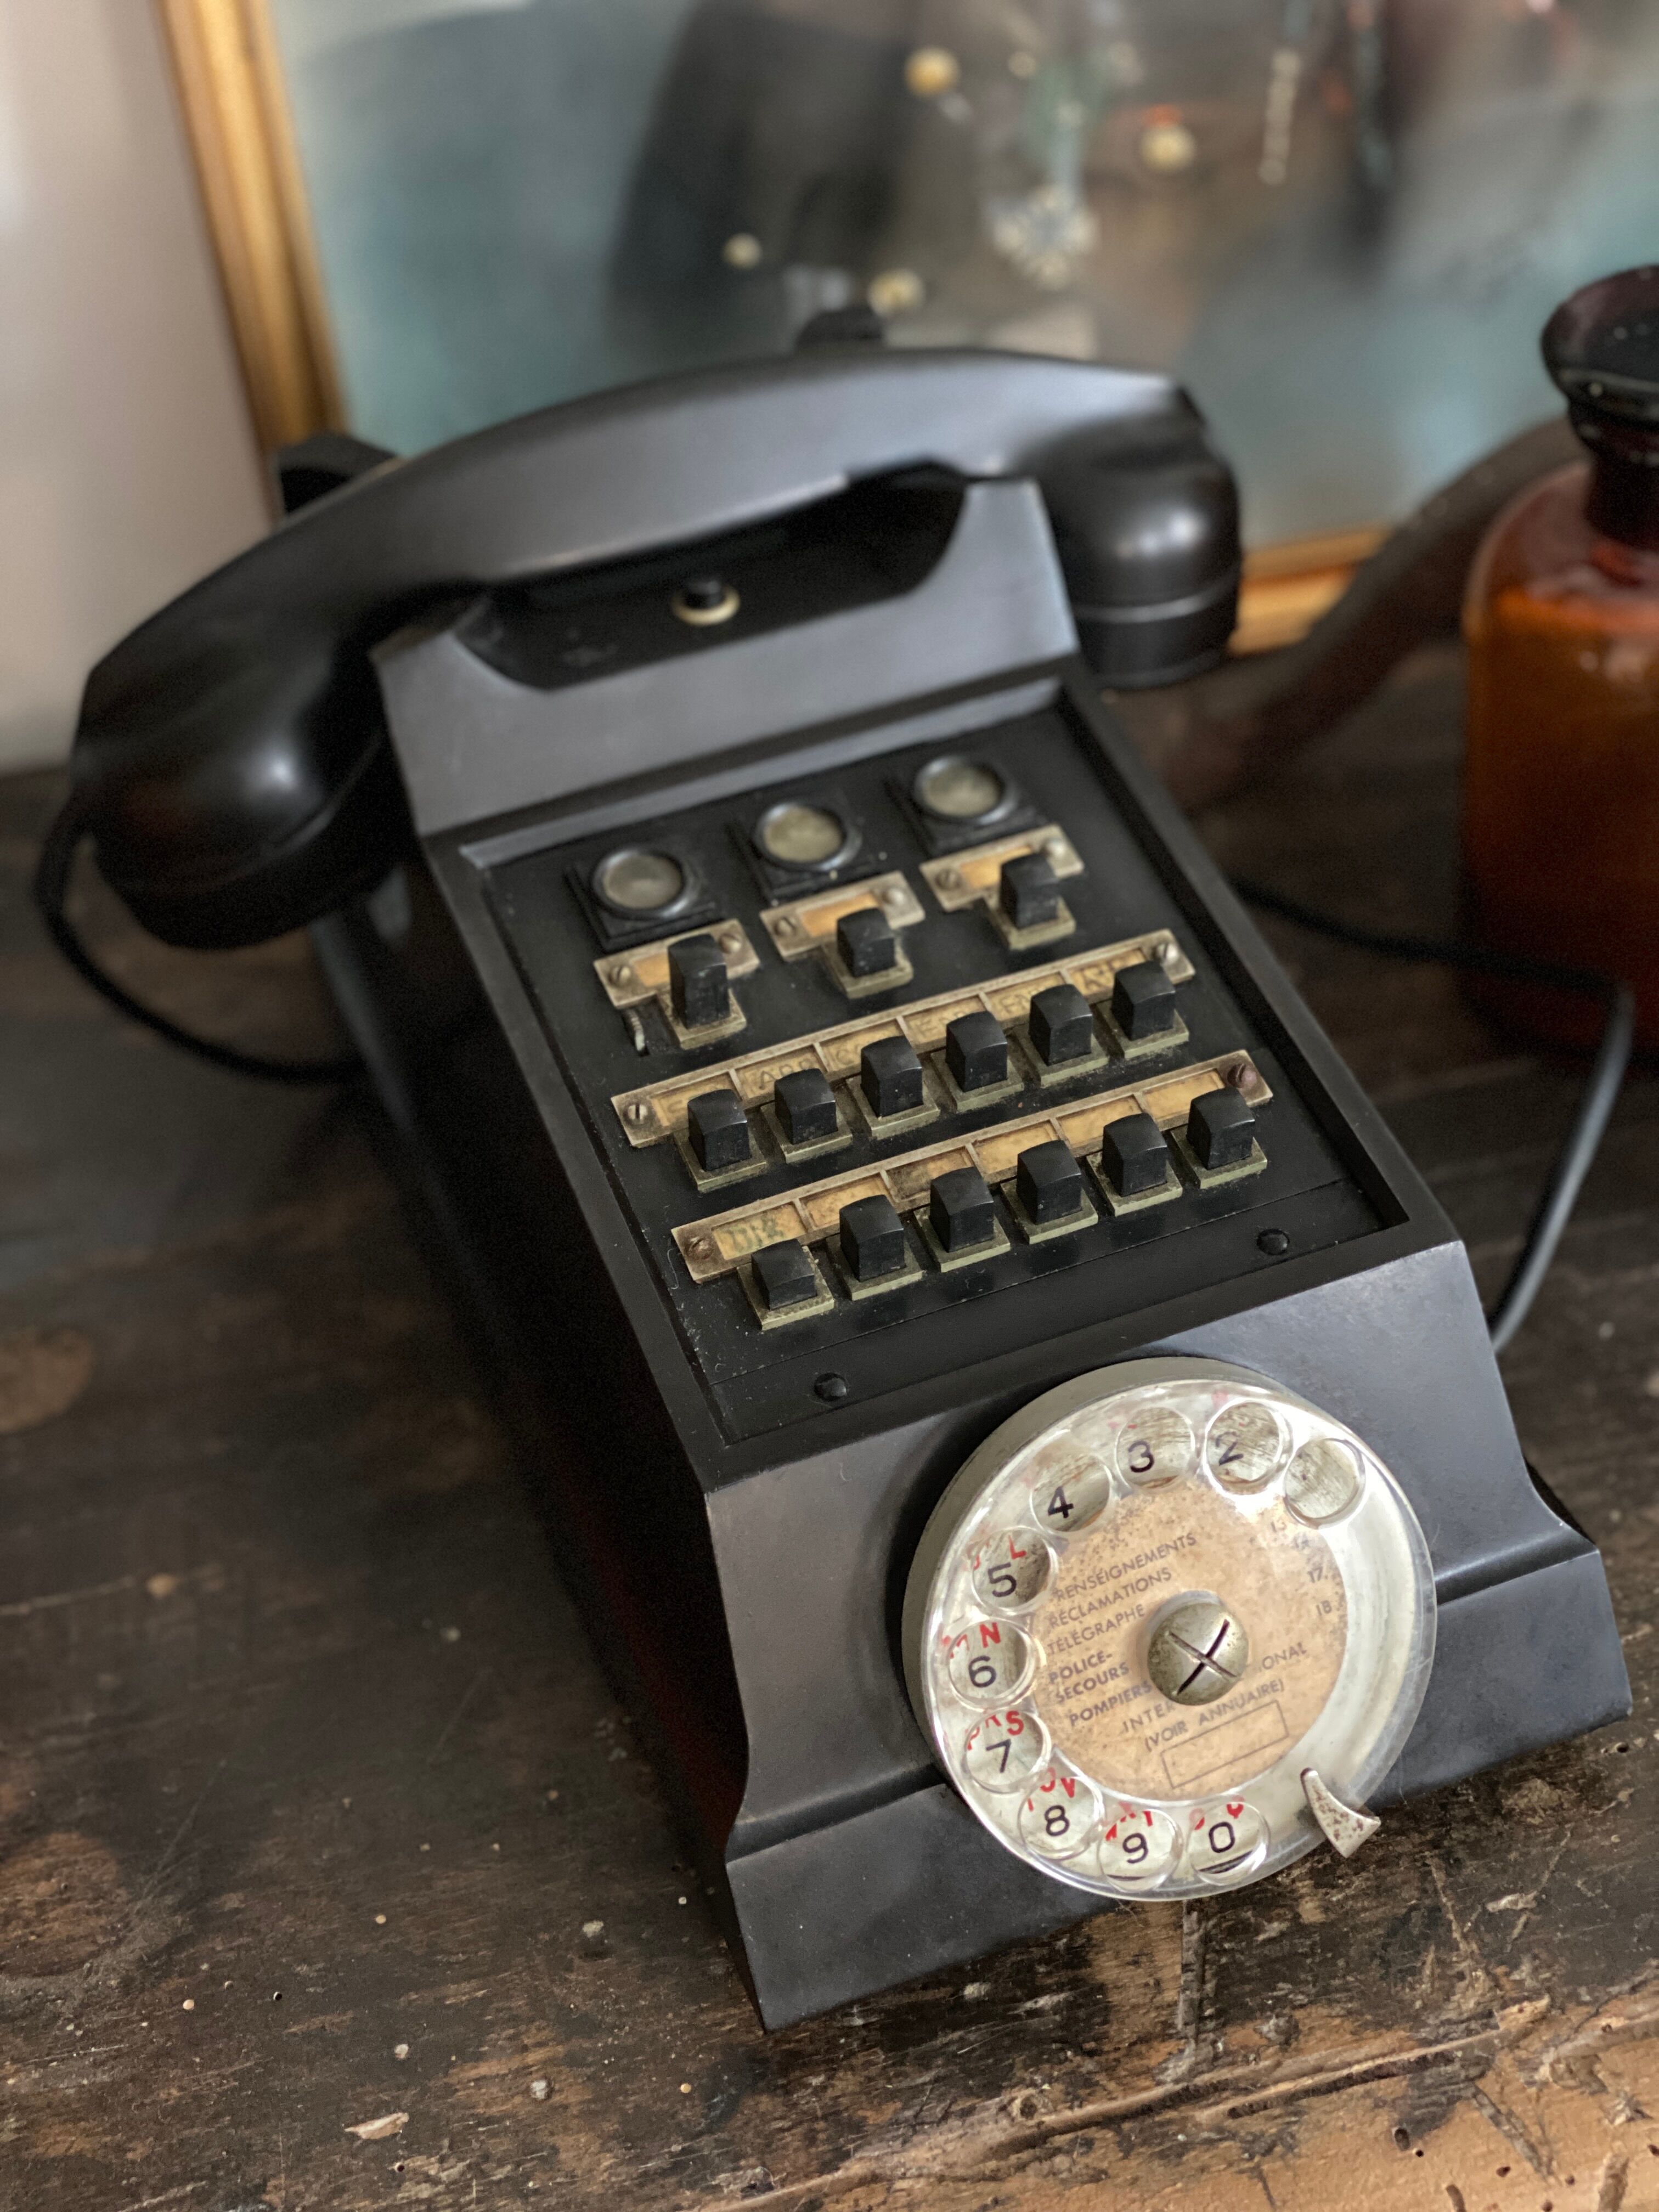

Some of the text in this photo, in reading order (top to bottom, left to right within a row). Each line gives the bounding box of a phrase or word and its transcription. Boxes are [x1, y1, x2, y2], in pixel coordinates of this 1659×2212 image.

[1128, 1440, 1154, 1473] 3
[1215, 1431, 1243, 1466] 2
[1048, 1486, 1074, 1519] 4
[988, 1562, 1017, 1598] 5
[968, 1655, 997, 1688] 6
[1049, 1650, 1113, 1684] POLICE-
[1259, 1643, 1307, 1671] ONAL
[1056, 1662, 1129, 1703] SECOURS
[1070, 1680, 1152, 1726] POMPIERS
[986, 1739, 1012, 1773] 7
[1044, 1805, 1070, 1837] 8
[1209, 1821, 1235, 1853] 0
[1122, 1833, 1148, 1864] 9
